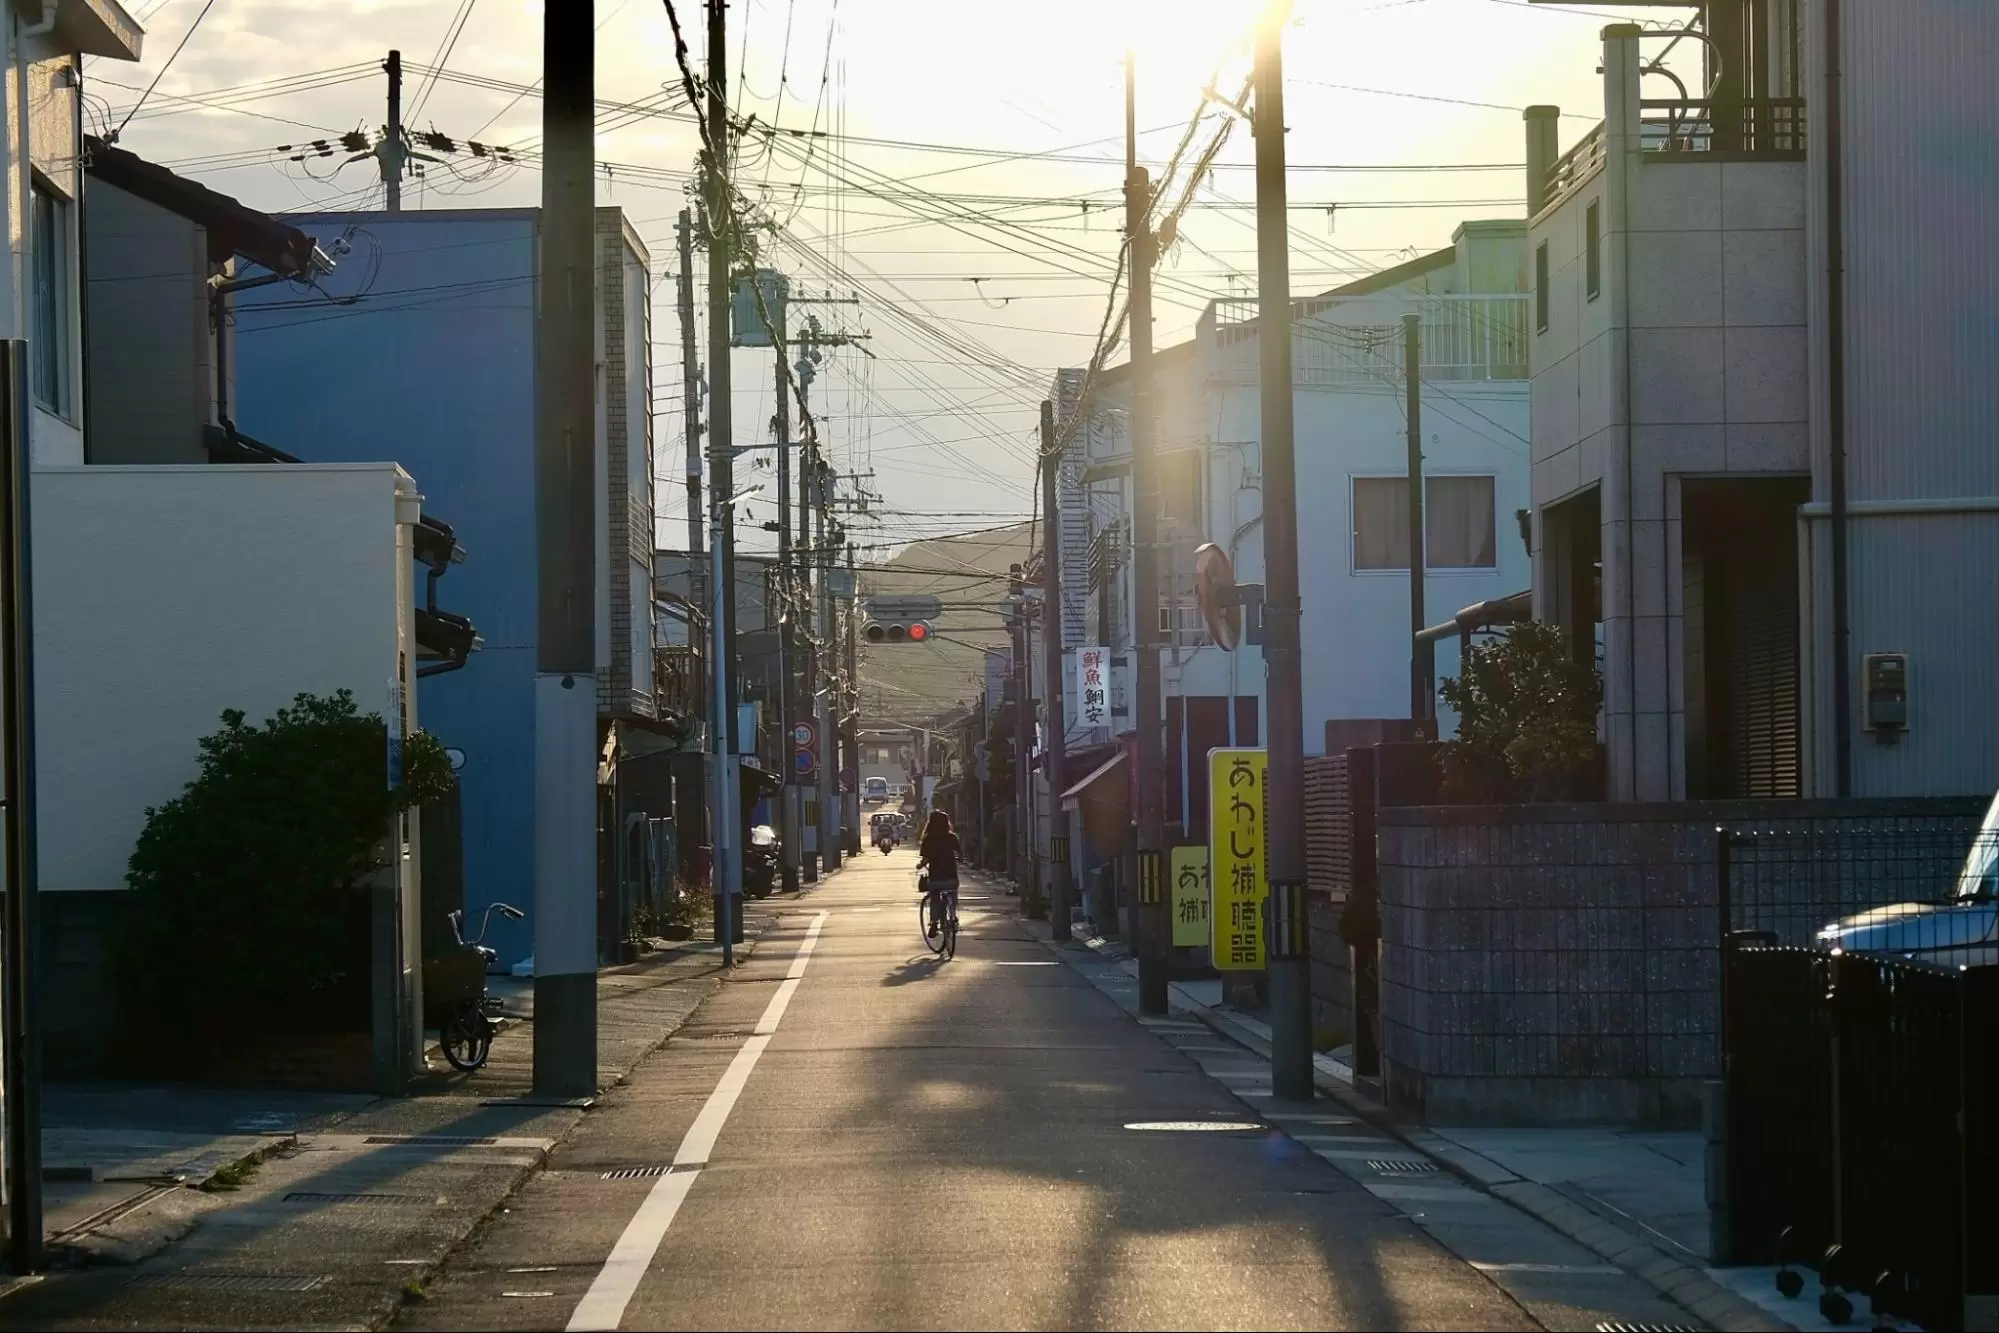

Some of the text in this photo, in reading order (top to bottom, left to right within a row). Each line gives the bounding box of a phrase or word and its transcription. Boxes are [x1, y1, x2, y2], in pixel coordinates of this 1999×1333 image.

[1229, 757, 1257, 963] あわじ補聴器
